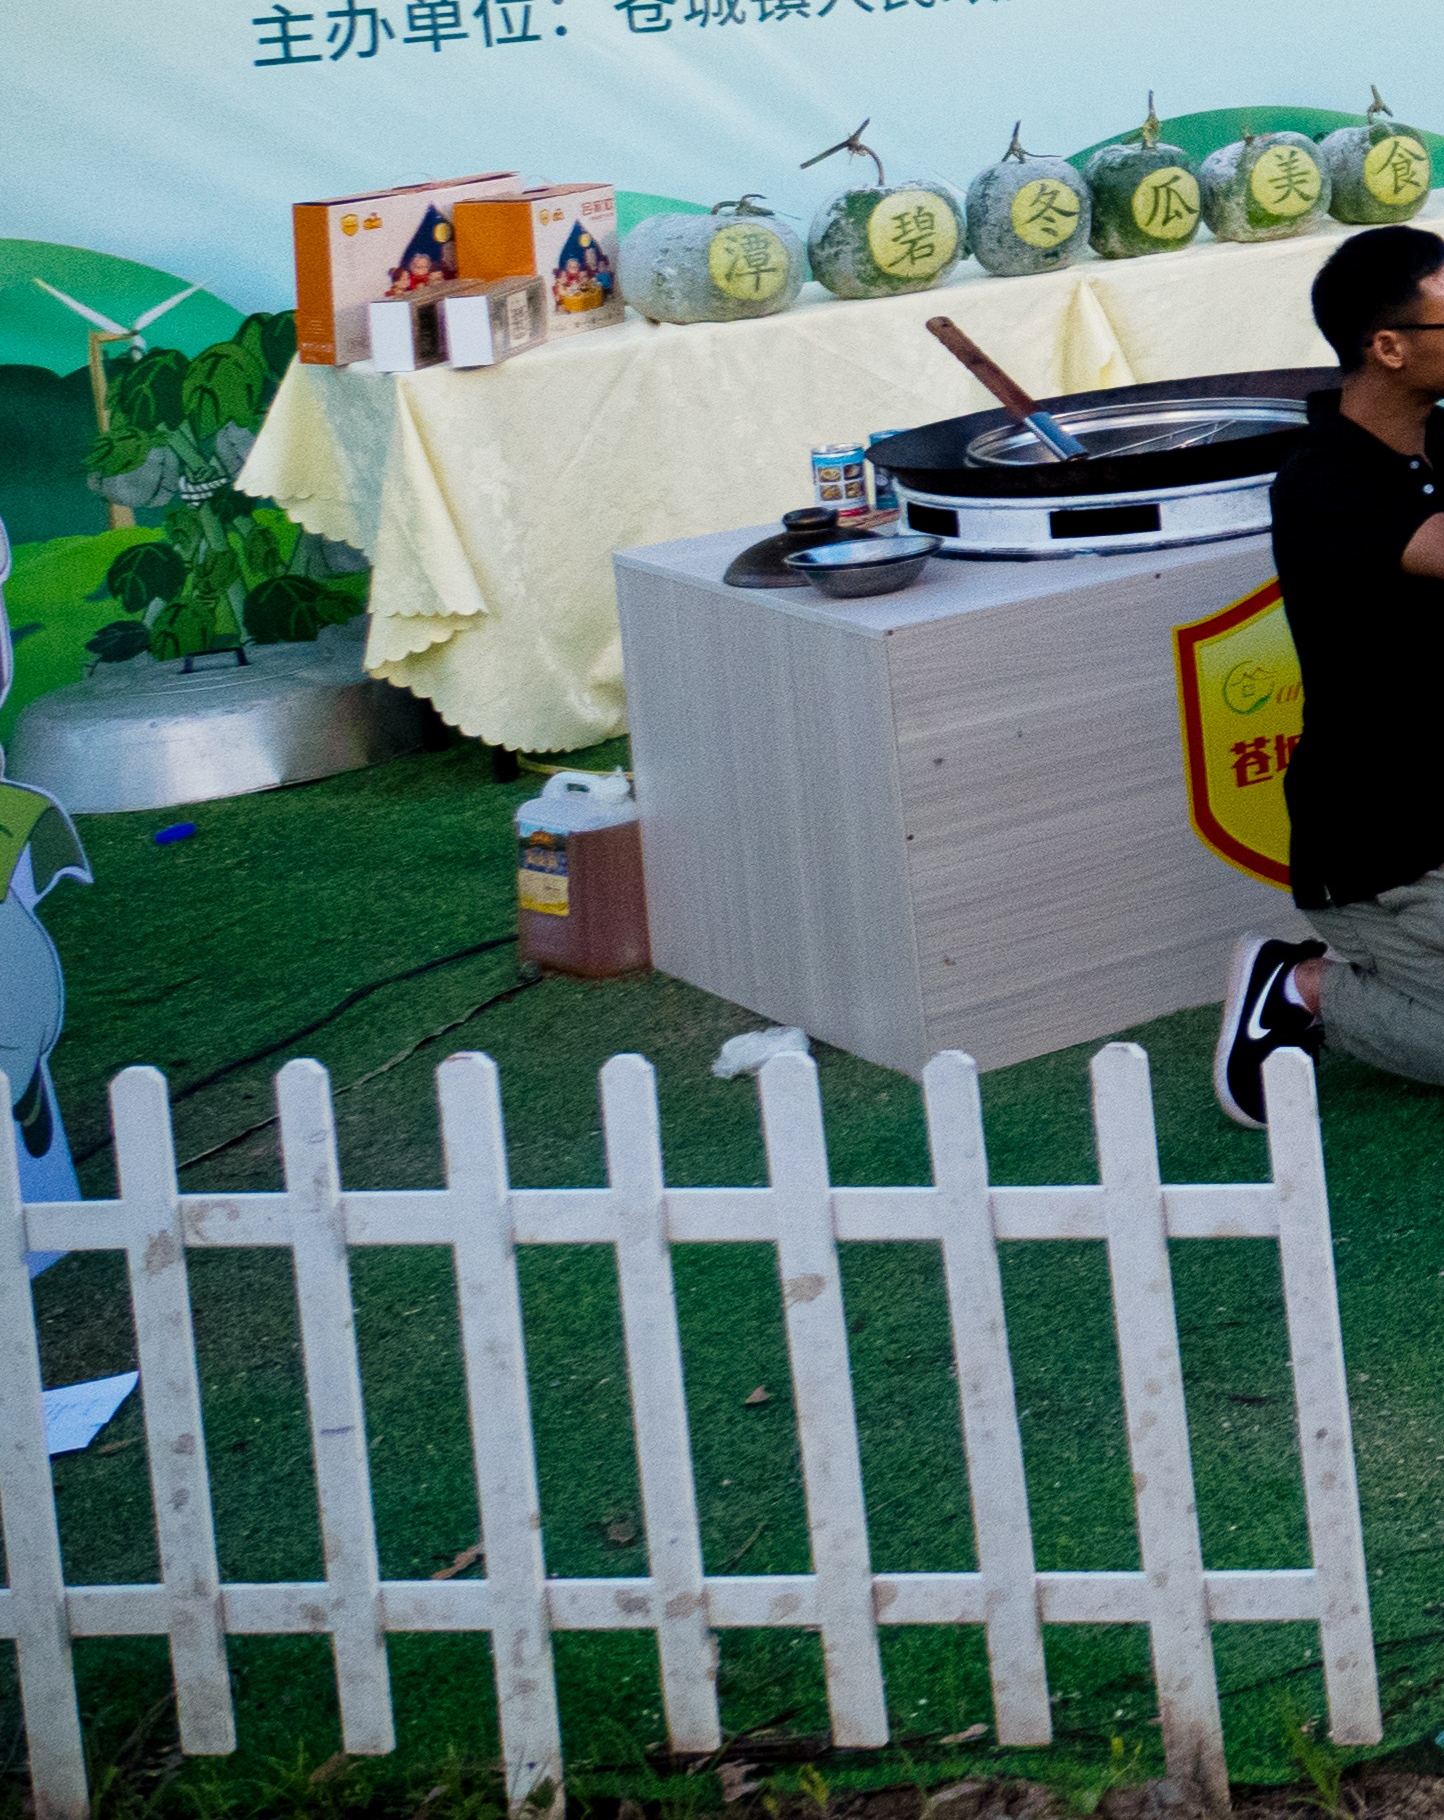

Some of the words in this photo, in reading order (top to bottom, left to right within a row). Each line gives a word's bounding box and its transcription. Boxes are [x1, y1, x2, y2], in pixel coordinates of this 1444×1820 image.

[1273, 151, 1322, 205] 美
[1375, 139, 1426, 196] 食
[1028, 181, 1081, 239] 冬
[1145, 177, 1199, 226] 瓜
[724, 232, 777, 293] 潭
[889, 204, 936, 271] 碧
